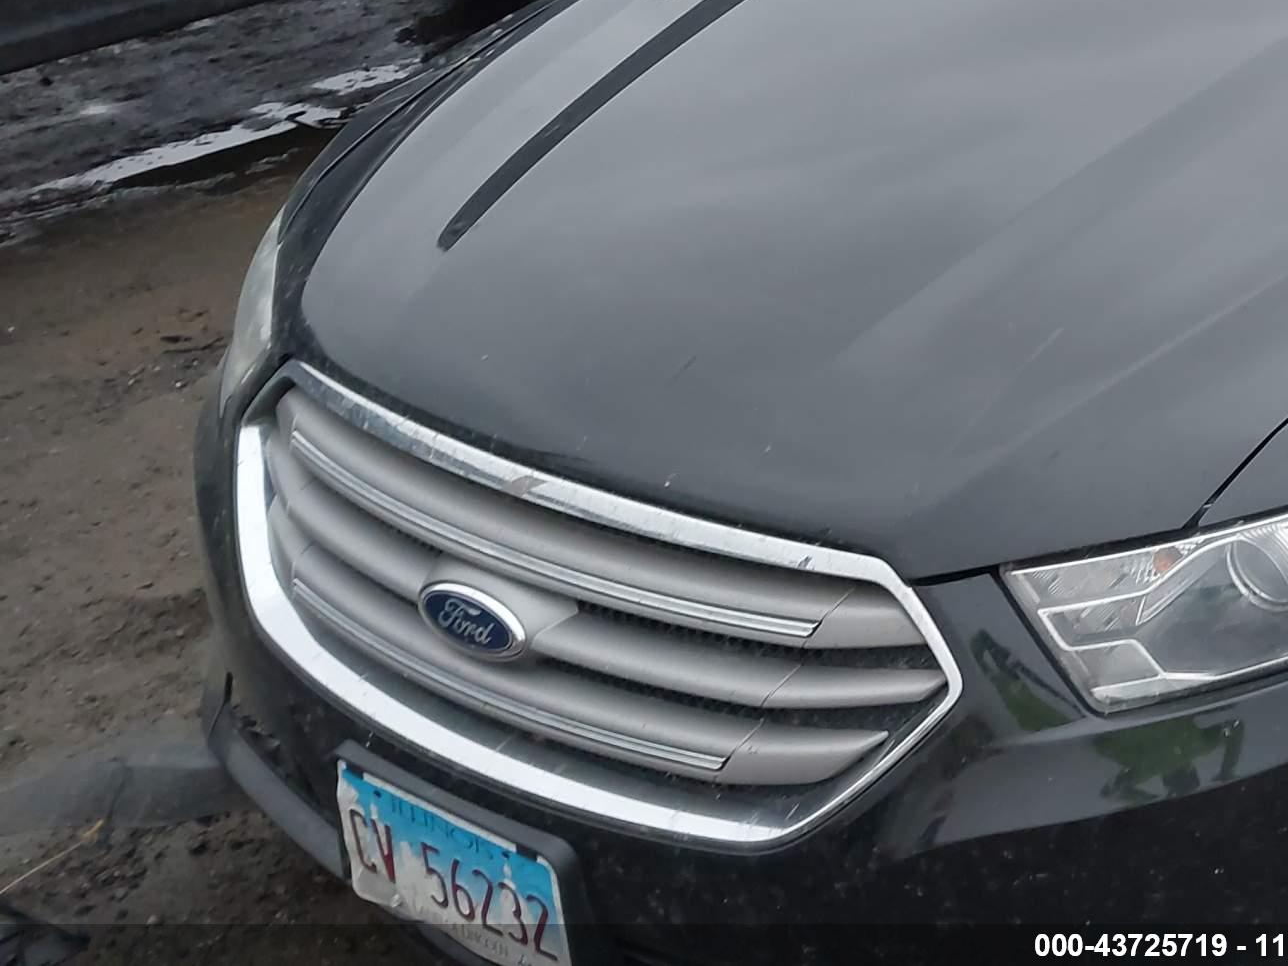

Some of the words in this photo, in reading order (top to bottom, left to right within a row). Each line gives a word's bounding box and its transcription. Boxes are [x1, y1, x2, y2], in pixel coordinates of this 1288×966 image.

[438, 598, 495, 645] Ford
[349, 809, 396, 884] CV
[420, 841, 558, 962] 56232
